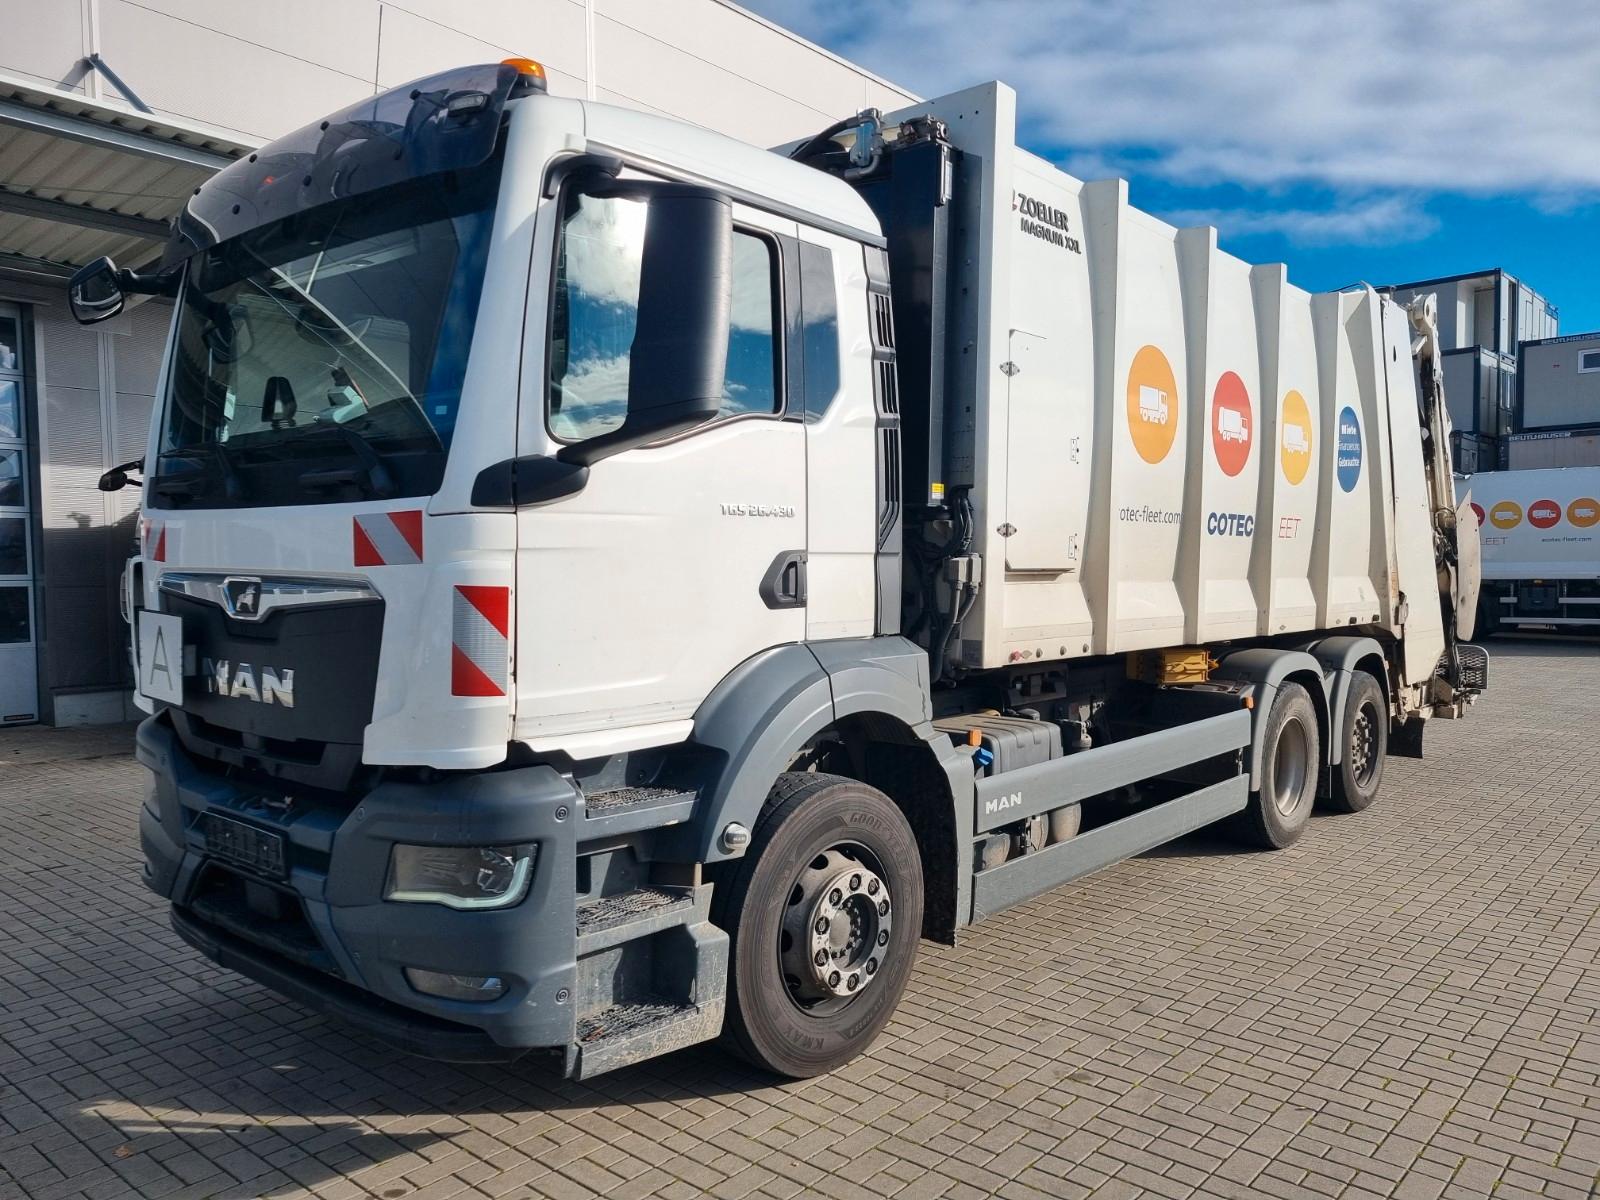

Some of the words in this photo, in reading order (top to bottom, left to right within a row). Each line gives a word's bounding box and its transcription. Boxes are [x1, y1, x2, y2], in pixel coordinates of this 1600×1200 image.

[1018, 192, 1069, 233] ZOELLER
[1020, 217, 1064, 248] MAGNUM
[1065, 235, 1082, 255] XXL
[1207, 511, 1254, 537] COTEC
[149, 624, 174, 692] A
[204, 656, 295, 708] MAN
[985, 791, 1022, 815] MAN
